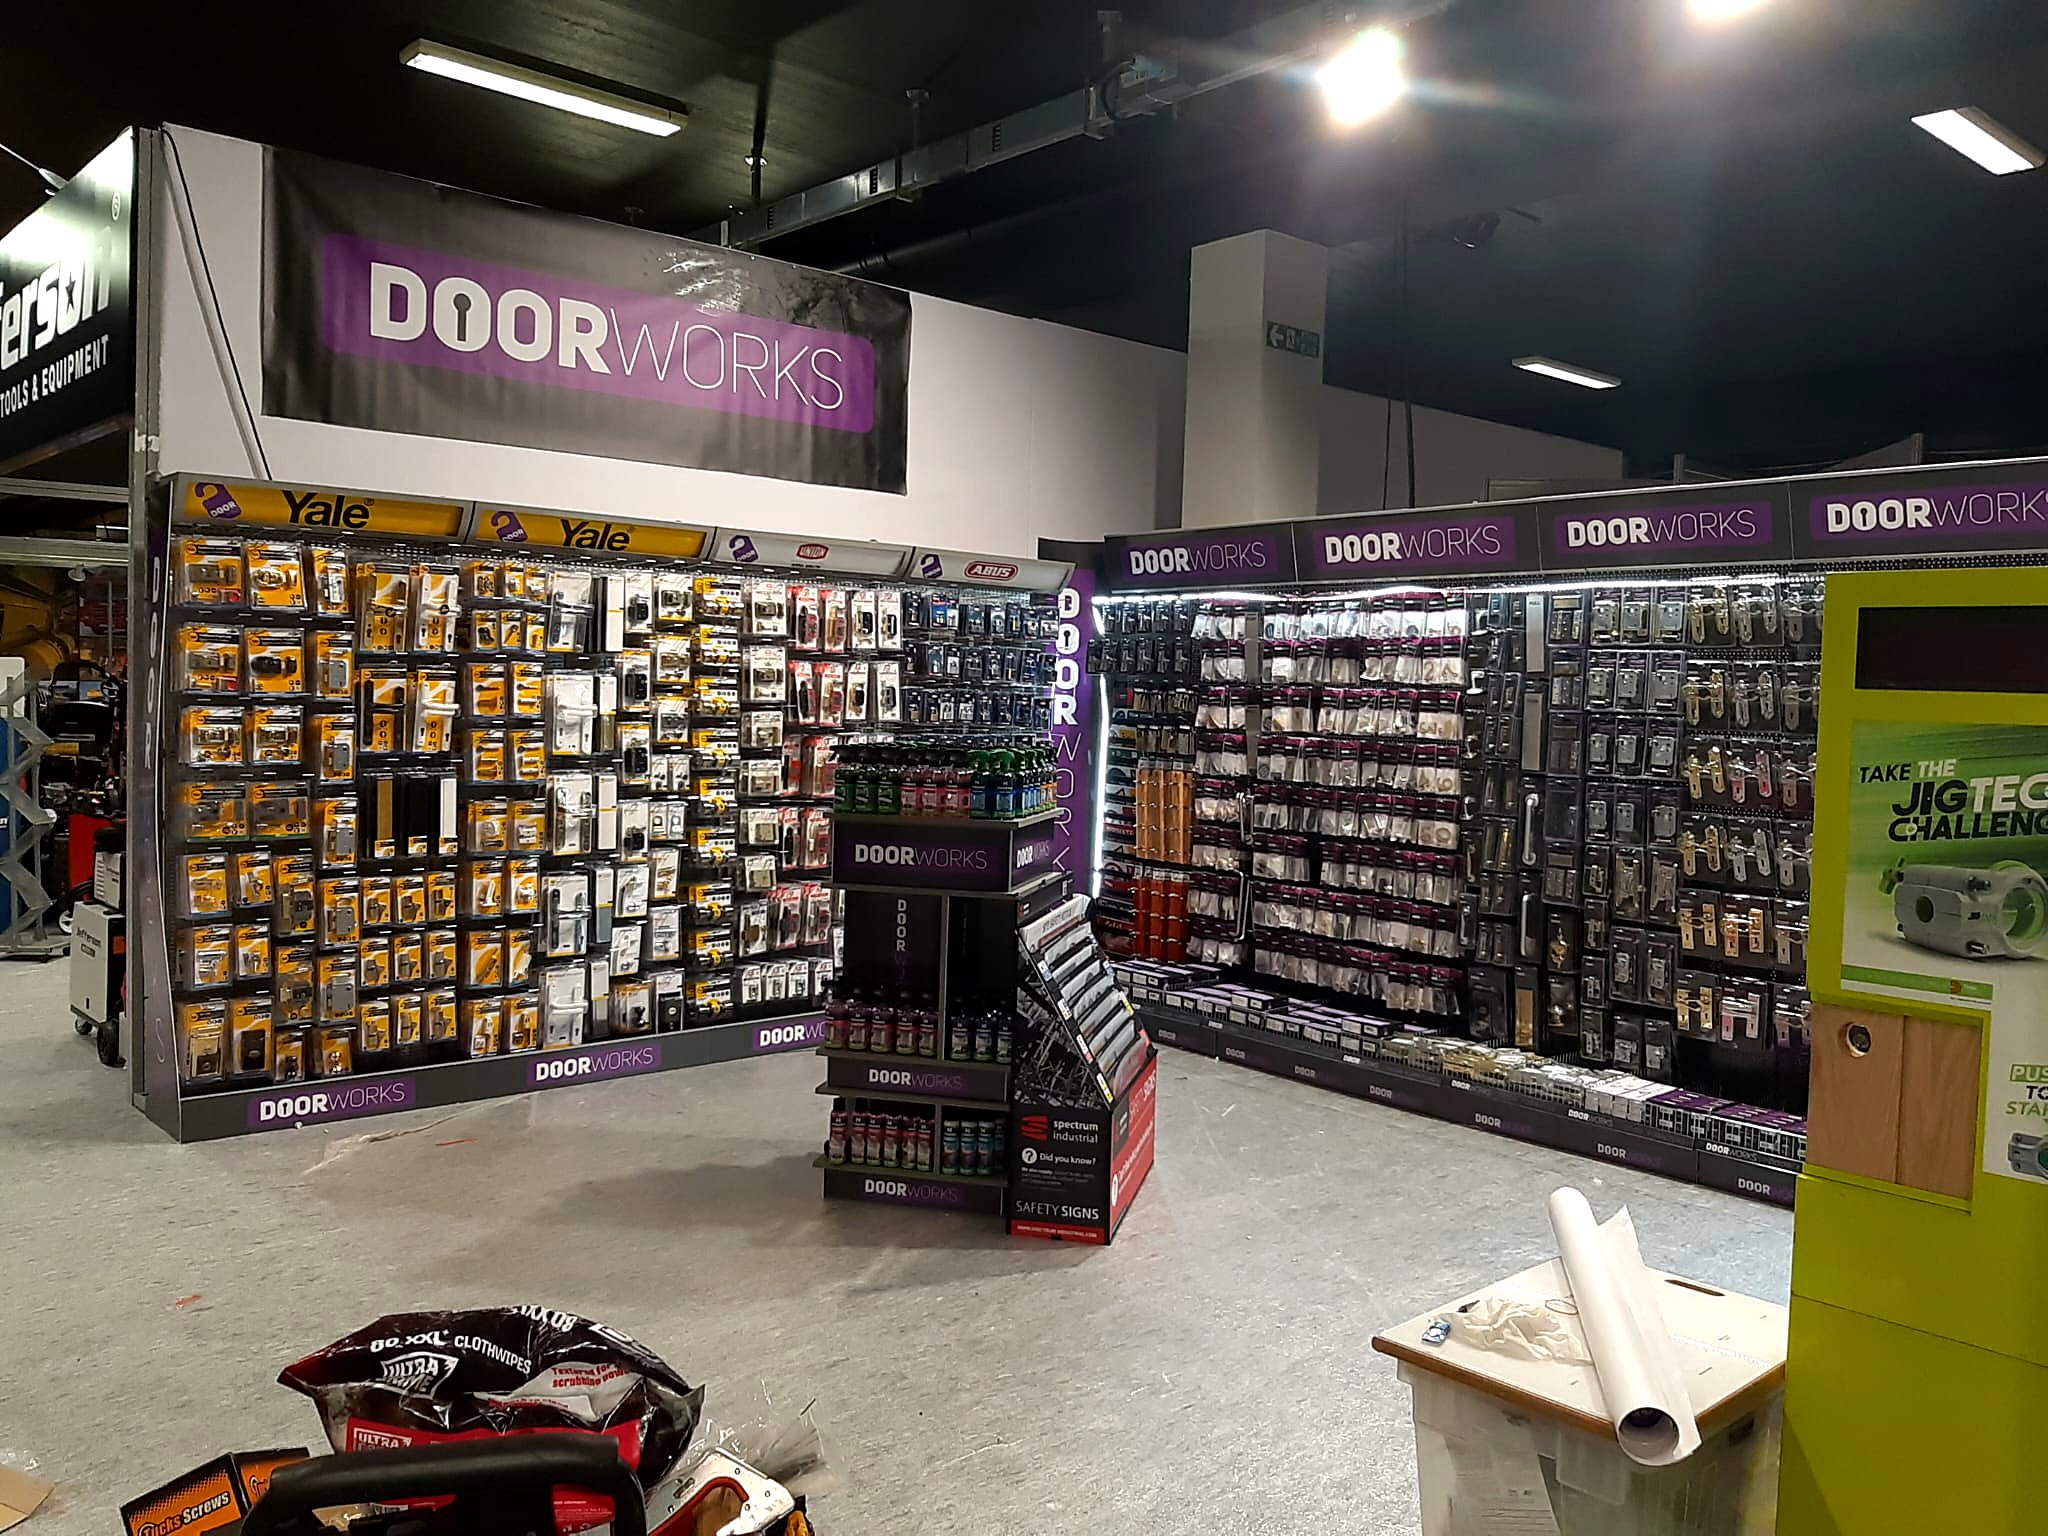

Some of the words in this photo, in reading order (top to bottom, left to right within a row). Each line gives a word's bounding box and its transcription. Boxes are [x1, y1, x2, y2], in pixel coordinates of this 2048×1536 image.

[0, 225, 111, 370] erson
[369, 261, 844, 410] DOORWORKS
[0, 380, 29, 418] TOOLS
[32, 374, 39, 402] &
[42, 334, 109, 397] EQUIPMENT
[210, 501, 237, 518] DOOR
[281, 489, 370, 528] Yale
[501, 528, 525, 543] DOOR
[560, 518, 630, 551] Yale
[1567, 508, 1757, 548] DOORWORKS
[1129, 541, 1267, 576] DOORWORKS
[1324, 524, 1502, 564] DOORWORKS
[970, 564, 1013, 579] ABUS
[1050, 587, 1082, 872] DOORWORK
[1859, 763, 1912, 784] TAKE
[1918, 758, 1957, 778] THE
[855, 843, 988, 870] DOORWORKS
[1016, 839, 1050, 869] DOORWORKS
[536, 1047, 653, 1081] DOORWORKS
[869, 1069, 962, 1090] DOORWORKS
[260, 1082, 405, 1121] DOORWORKS
[1053, 1120, 1099, 1132] spectrum
[1053, 1131, 1099, 1144] industrial
[1039, 1152, 1054, 1162] Did
[1055, 1155, 1070, 1164] you
[1070, 1156, 1097, 1166] know?
[865, 1179, 958, 1201] DOORWORKS
[1016, 1200, 1060, 1216] SAFETY
[1061, 1205, 1100, 1220] SIGNS
[454, 1335, 532, 1374] CLOTHWIPES
[357, 1430, 400, 1449] ULTRA
[182, 1491, 230, 1524] Screws
